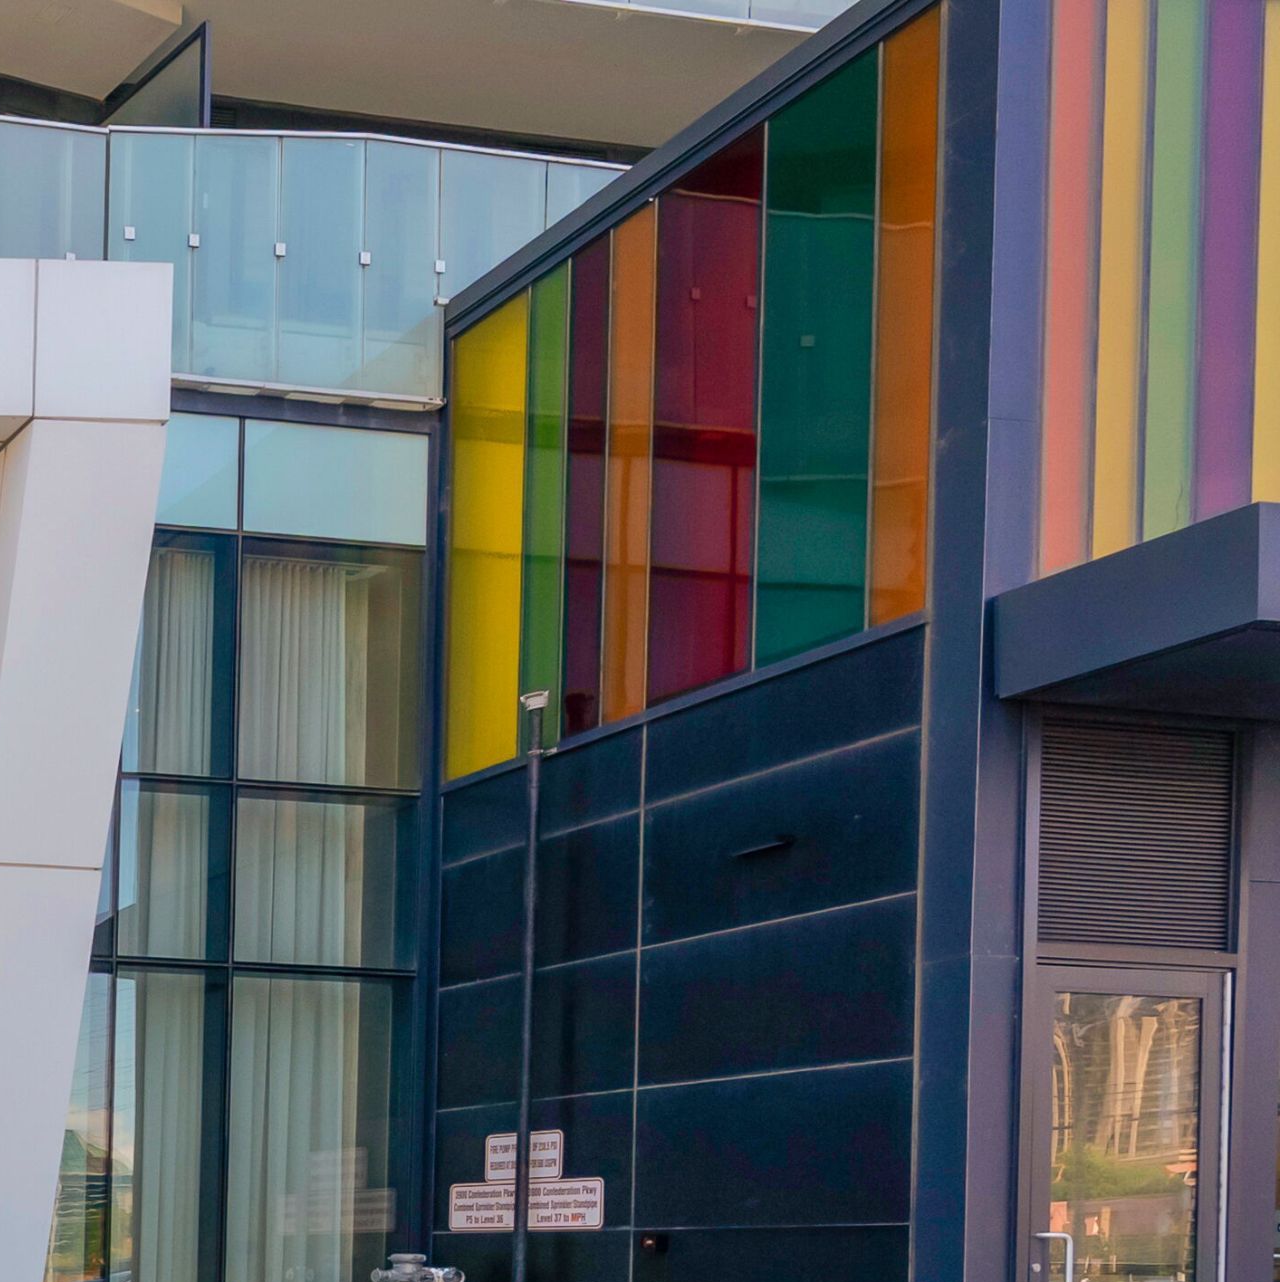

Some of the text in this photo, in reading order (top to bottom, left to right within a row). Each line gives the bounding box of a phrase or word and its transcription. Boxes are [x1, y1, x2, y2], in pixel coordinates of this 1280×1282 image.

[469, 1190, 503, 1199] Confederation
[543, 1187, 581, 1196] Confederation
[582, 1185, 597, 1196] Pkwy
[529, 1201, 550, 1210] ombined
[480, 1215, 495, 1224] Level
[537, 1213, 553, 1223] Level
[554, 1213, 562, 1223] 37
[563, 1214, 570, 1222] to
